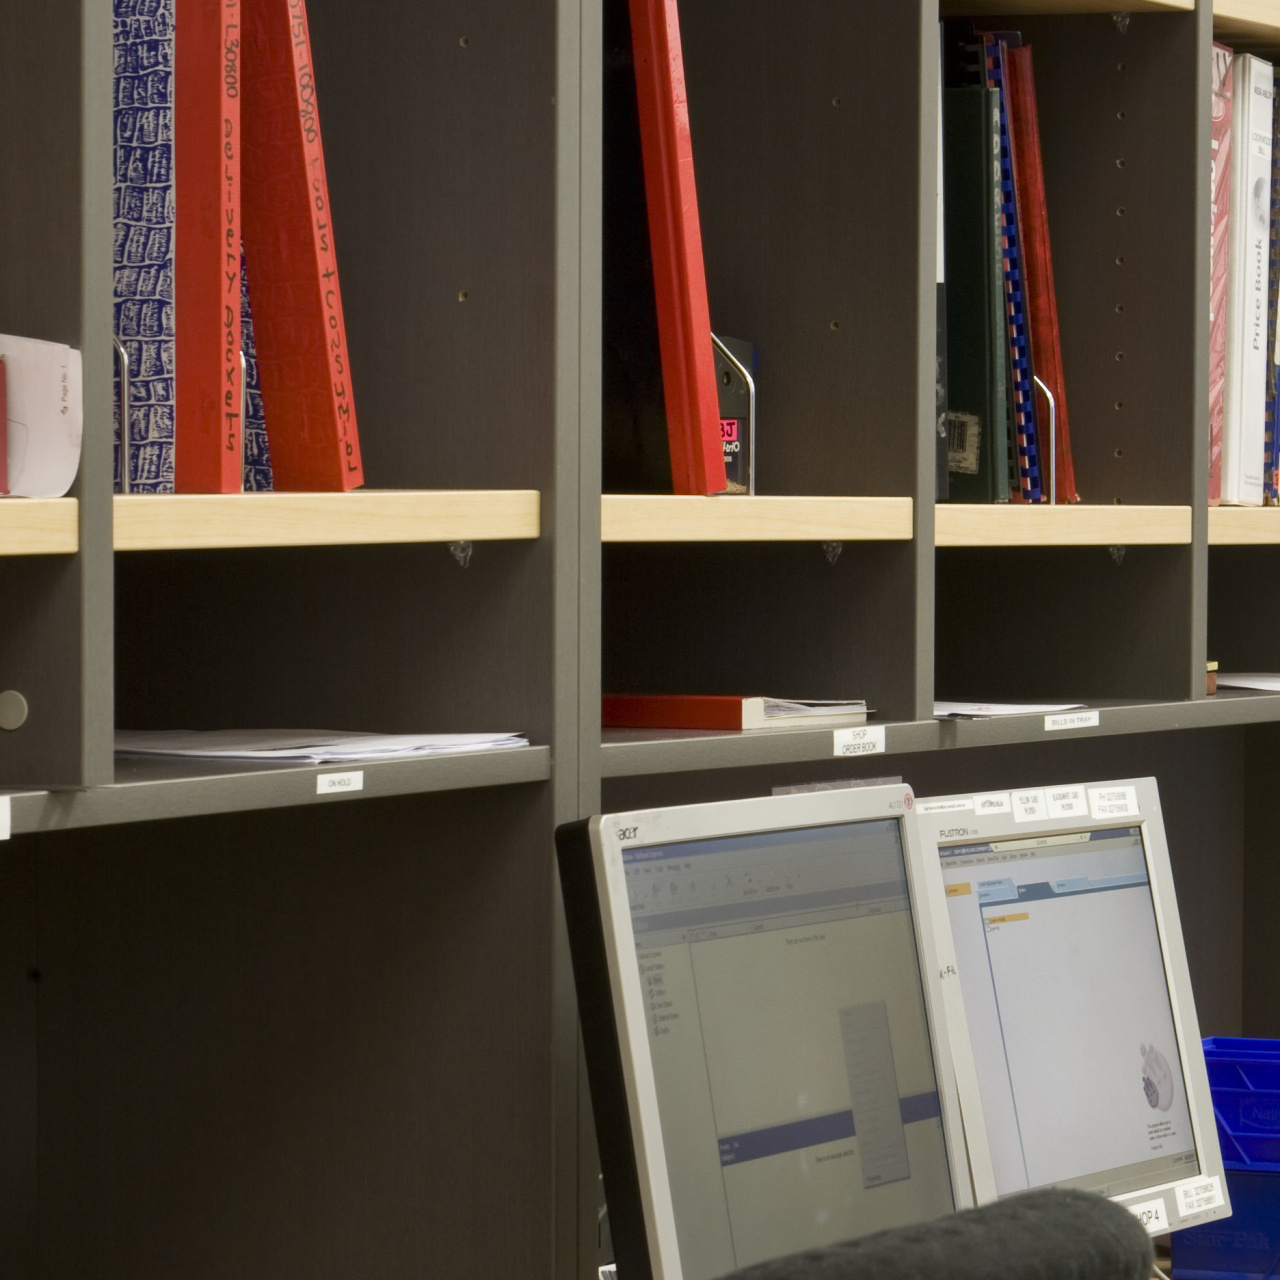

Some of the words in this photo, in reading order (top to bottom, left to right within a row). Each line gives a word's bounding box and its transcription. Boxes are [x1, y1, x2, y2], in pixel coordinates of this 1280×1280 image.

[1254, 237, 1263, 292] Book
[1253, 298, 1262, 351] Price
[1051, 718, 1068, 727] BILLS
[1075, 716, 1092, 725] TRAY
[851, 729, 868, 740] SHOP
[841, 743, 861, 755] ORDER
[861, 741, 877, 753] BOOK
[328, 779, 337, 788] ON
[336, 777, 352, 787] HOLD
[618, 825, 639, 841] acer
[939, 827, 969, 838] FLATRON
[1155, 1209, 1160, 1220] 4
